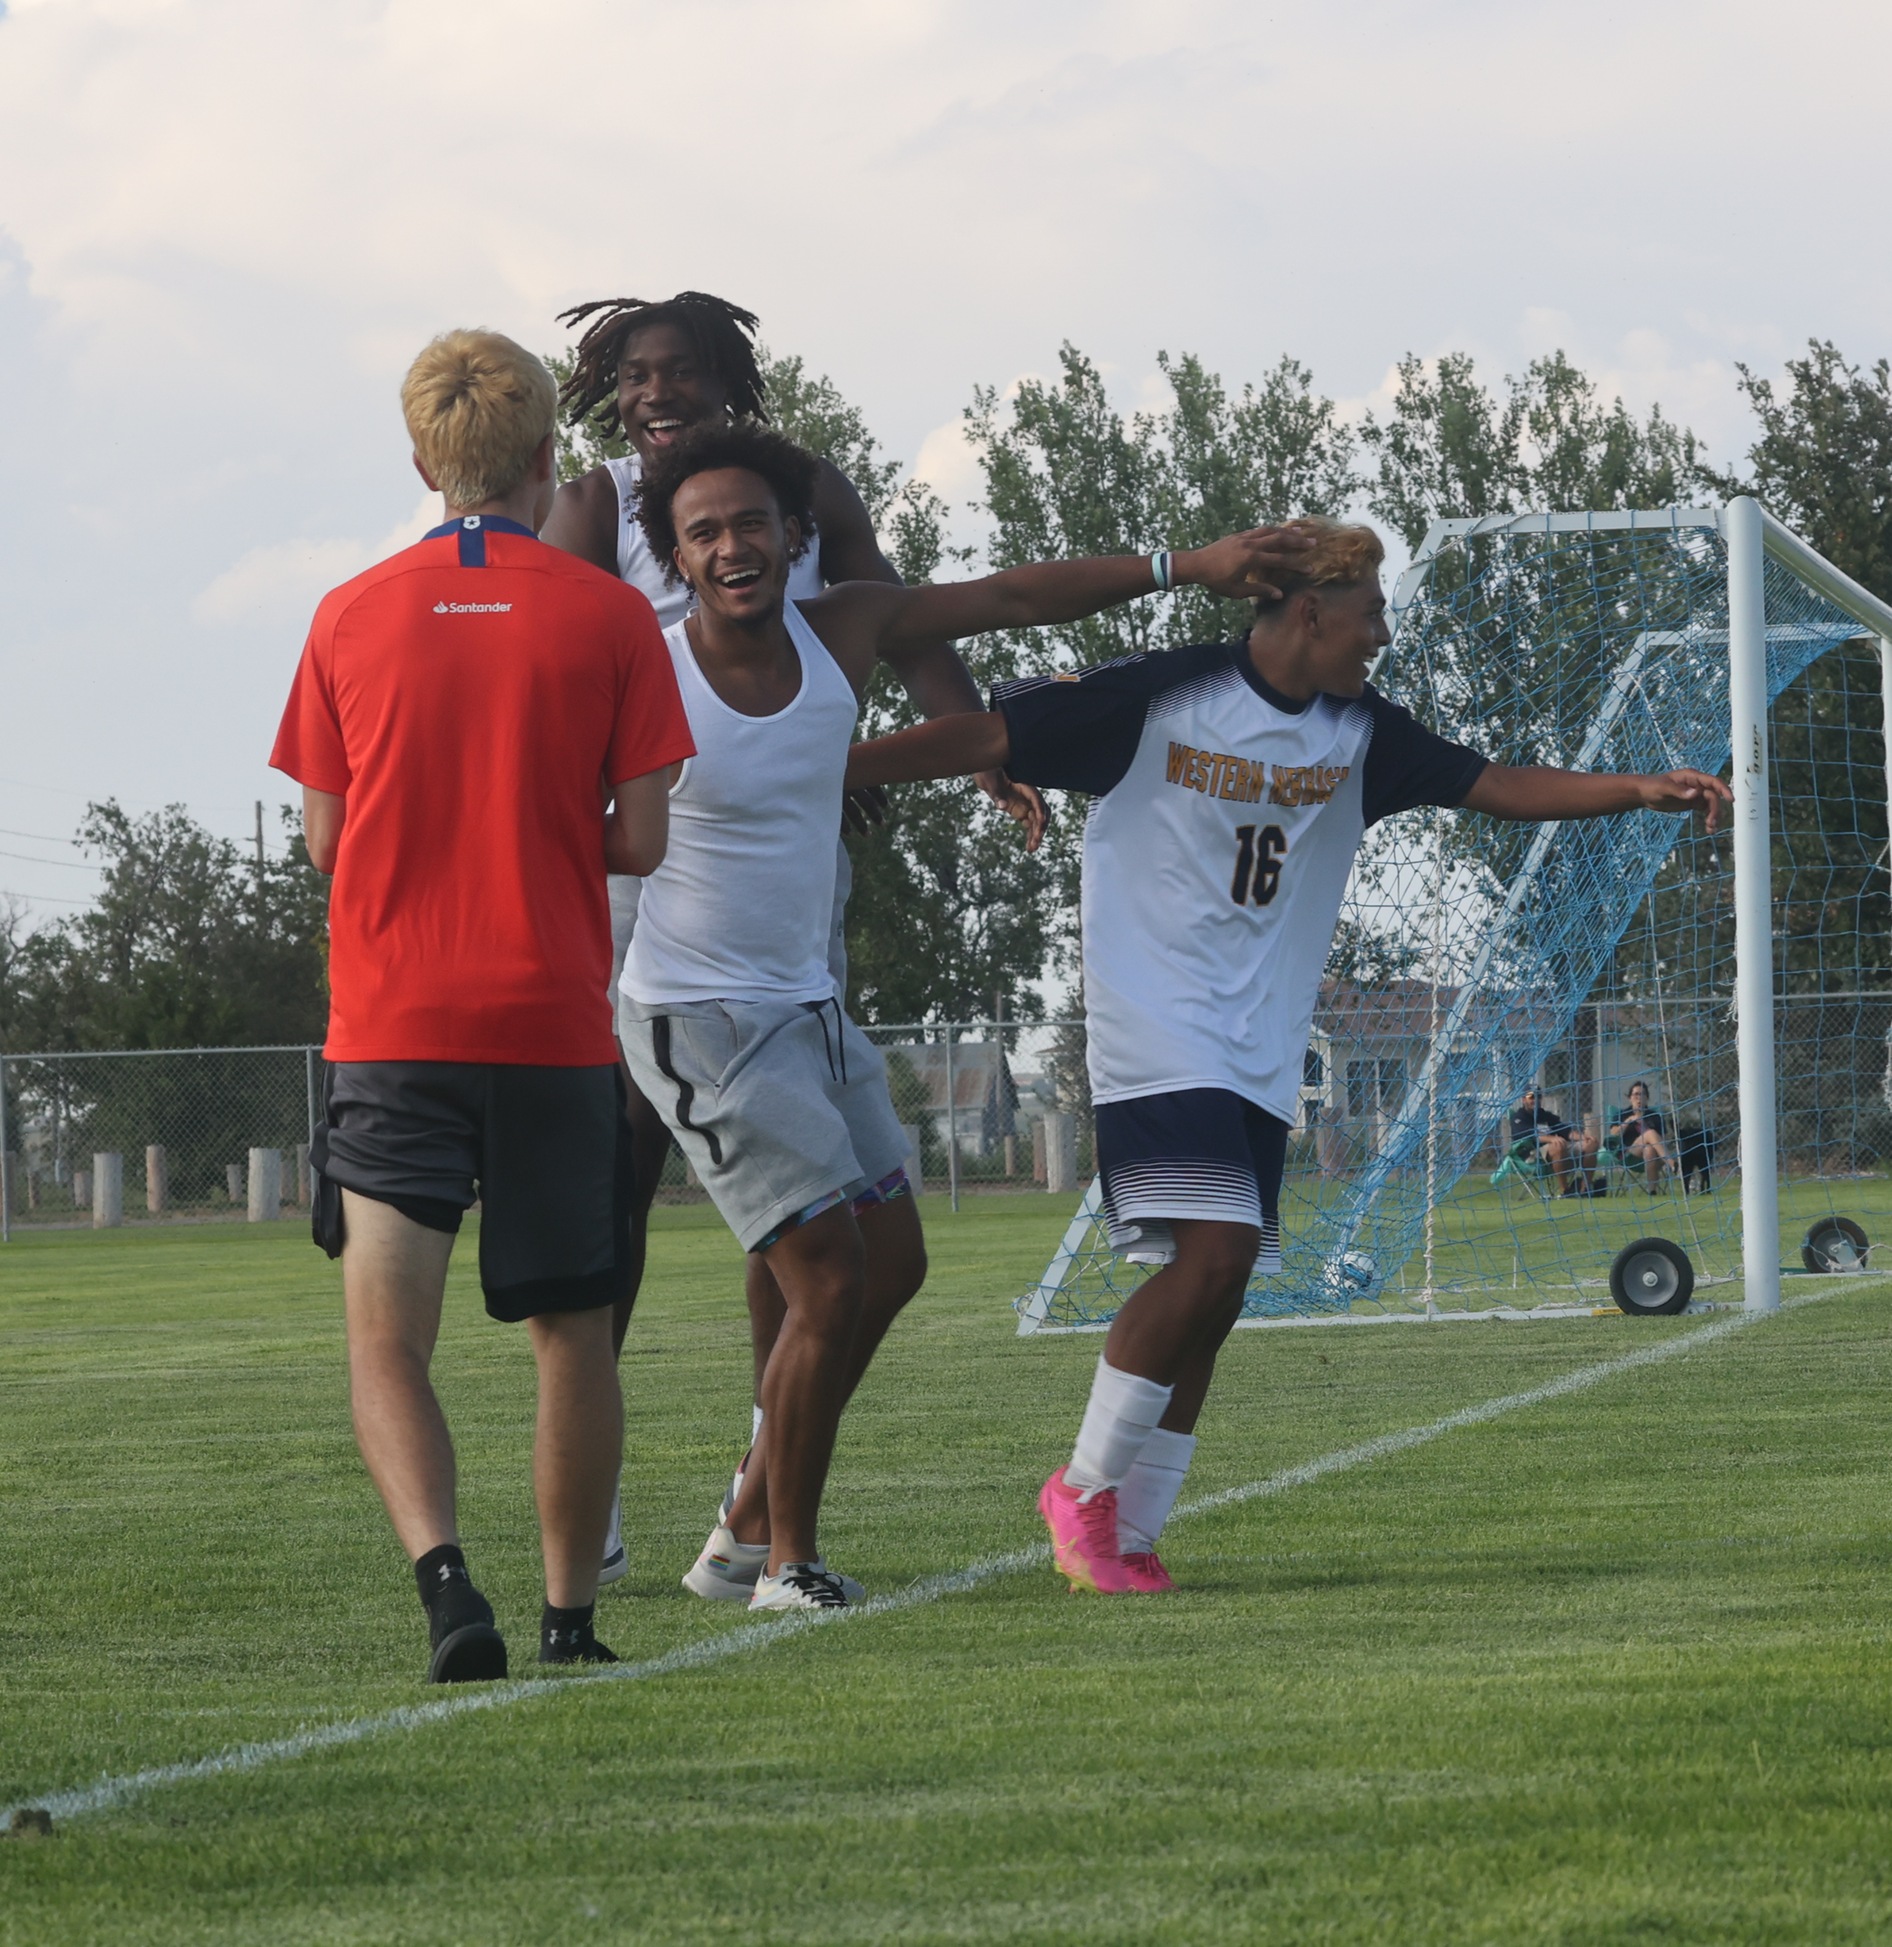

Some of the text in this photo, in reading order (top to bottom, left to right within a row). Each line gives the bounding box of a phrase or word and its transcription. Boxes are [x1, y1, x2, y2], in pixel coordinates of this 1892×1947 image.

[449, 602, 512, 613] Santander
[1166, 741, 1264, 803] WESTERN
[1230, 823, 1288, 907] 16
